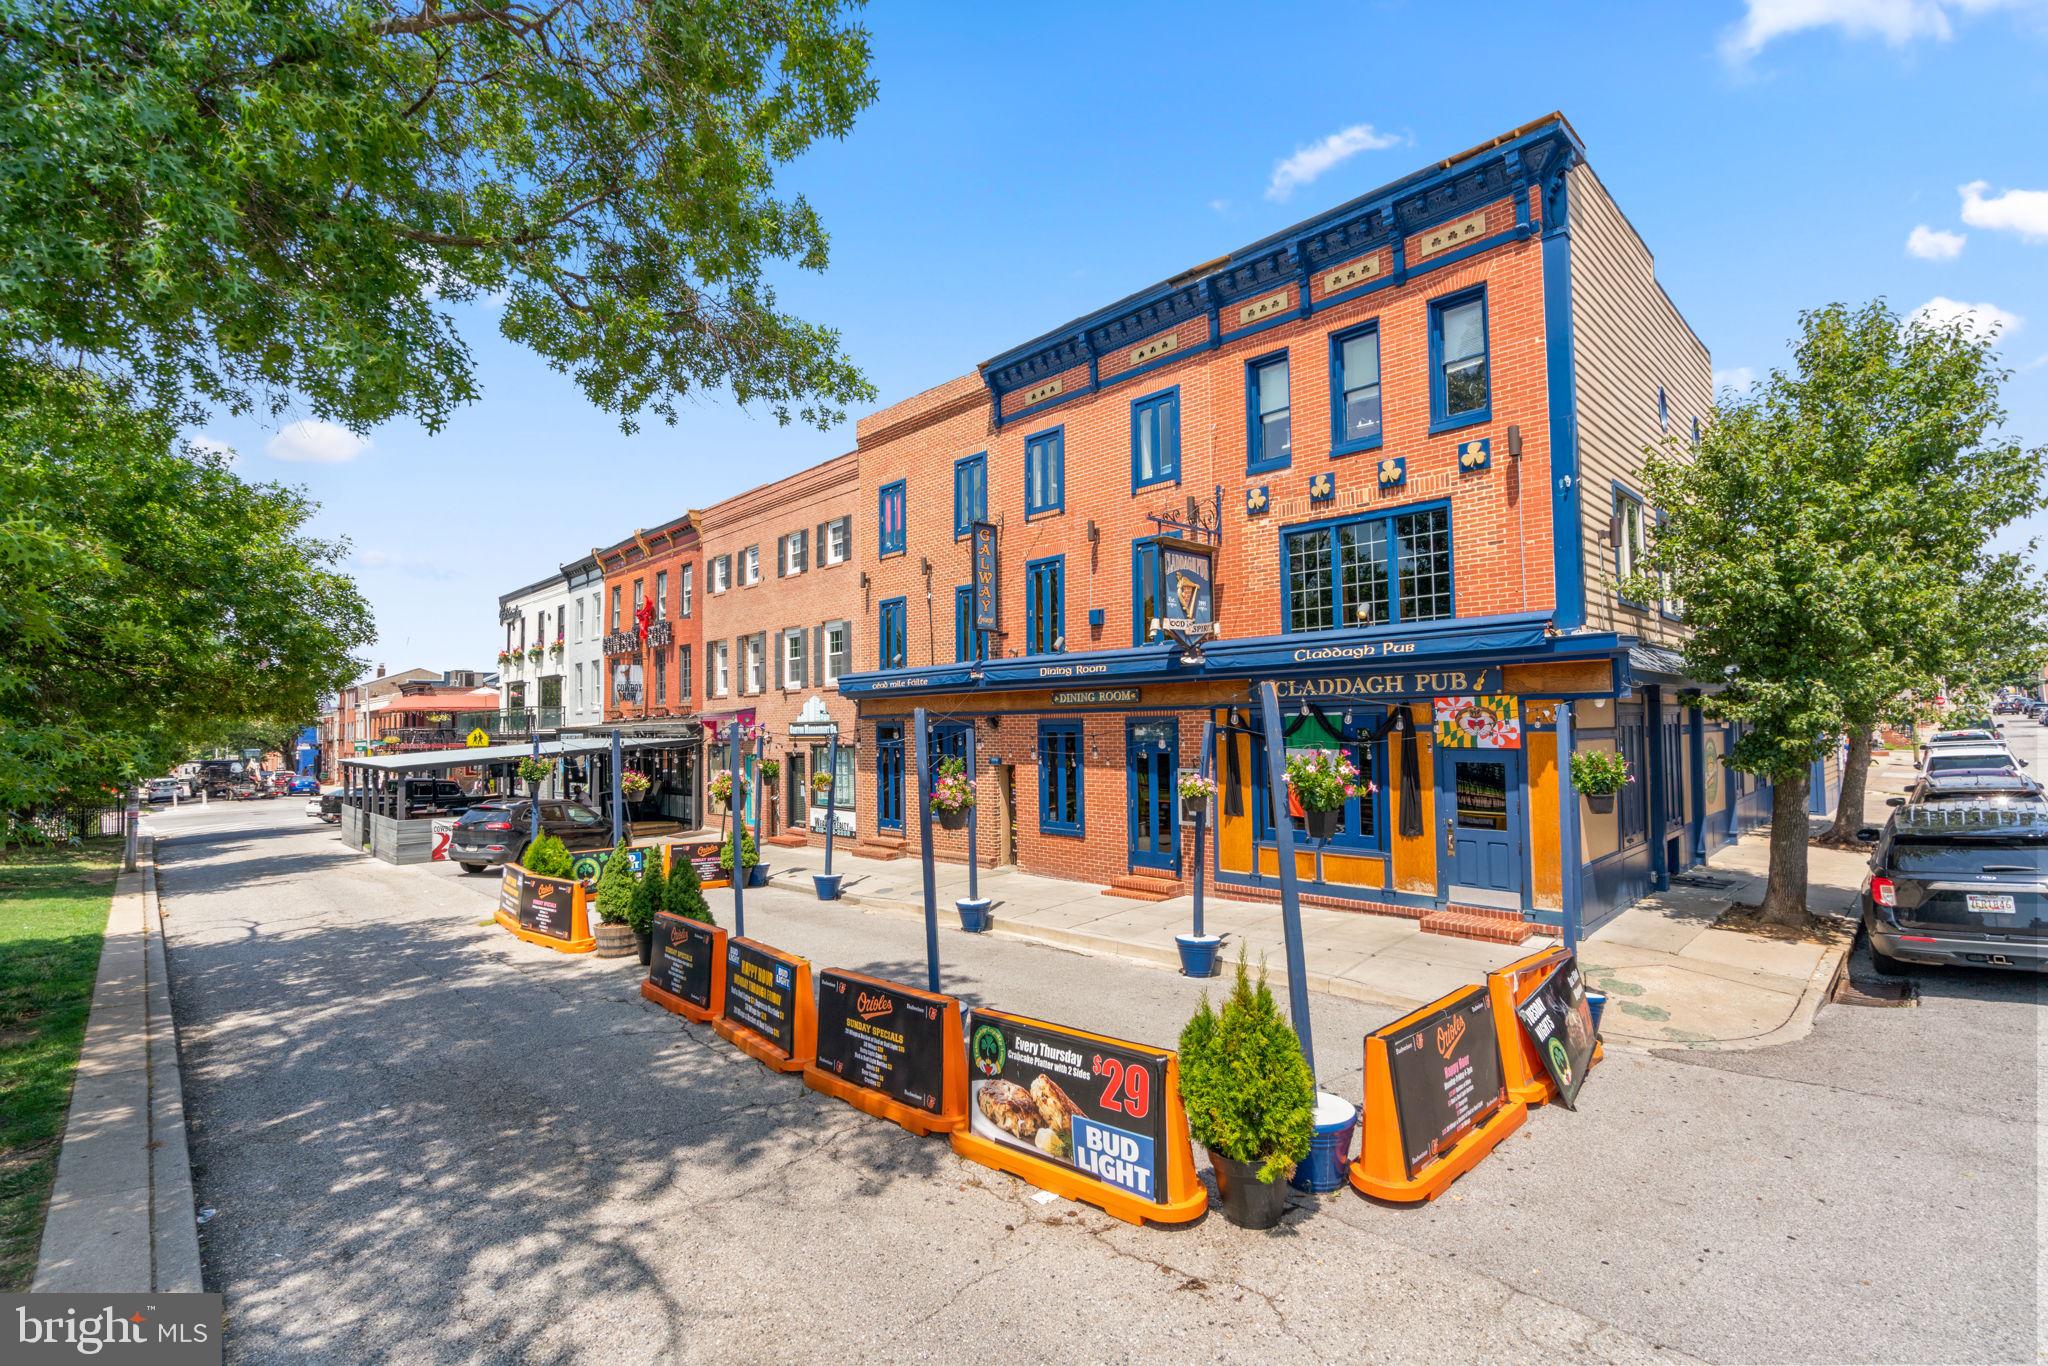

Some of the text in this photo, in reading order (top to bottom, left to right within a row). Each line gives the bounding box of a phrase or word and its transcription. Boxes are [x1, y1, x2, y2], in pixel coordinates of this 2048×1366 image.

[978, 529, 993, 613] GALWAY
[1294, 642, 1415, 661] Claddagh Pub
[1040, 664, 1107, 678] Dining Room
[1276, 672, 1467, 698] CLADDAGH PUB
[1059, 690, 1131, 703] DINING ROOM
[433, 825, 452, 833] COWBO
[857, 992, 893, 1016] Orioles
[846, 1018, 904, 1044] SUNDAY SPECIALS
[1437, 1014, 1466, 1057] Orioles
[1534, 1014, 1555, 1042] NIGHTS
[1007, 1049, 1091, 1081] Crabcake Platter with 2 Sides
[1015, 1036, 1083, 1067] Every Thursday
[1093, 1054, 1150, 1118] $29
[1085, 1125, 1140, 1164] BUD
[1077, 1146, 1151, 1194] LIGHT
